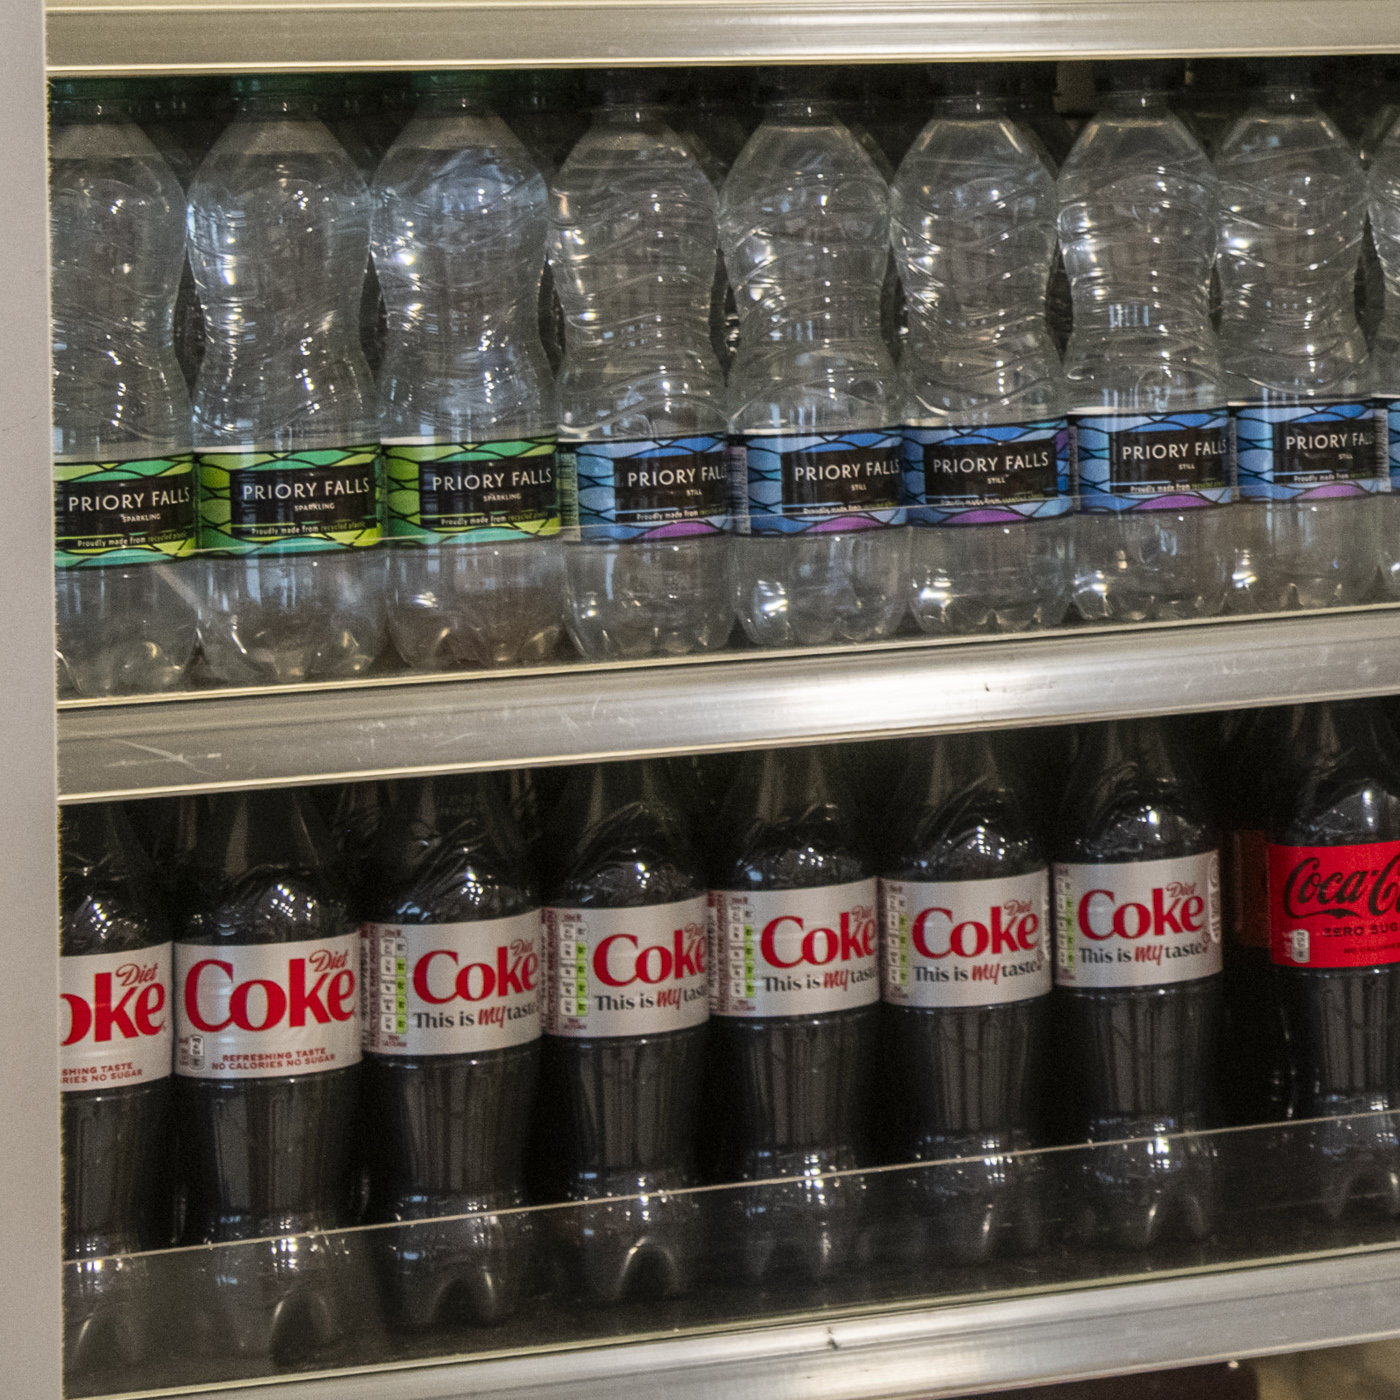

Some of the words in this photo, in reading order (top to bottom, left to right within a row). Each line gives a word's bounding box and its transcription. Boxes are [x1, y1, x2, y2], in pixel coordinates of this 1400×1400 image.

[1123, 443, 1188, 461] PRIORY
[1195, 439, 1227, 456] FALLS
[1286, 434, 1347, 451] PRIORY
[795, 463, 861, 482] PRIORY
[866, 459, 899, 477] FALLS
[933, 457, 998, 475] PRIORY
[1005, 452, 1048, 470] FALLS
[243, 482, 317, 501] PRIORY
[325, 477, 370, 496] FALLS
[432, 473, 505, 492] PRIORY
[512, 468, 552, 487] FALLS
[628, 468, 696, 488] PRIORY
[987, 476, 1005, 484] STILL
[69, 493, 145, 513] PRIORY
[152, 487, 190, 506] FALLS
[294, 502, 335, 513] SPARKLING
[483, 492, 522, 502] SPARKLING
[122, 513, 161, 524] SPARKLING
[78, 538, 106, 549] Proudly
[108, 536, 128, 546] made
[130, 535, 147, 545] from
[251, 526, 280, 537] Proudly
[281, 525, 299, 535] made
[301, 524, 319, 534] from
[1078, 887, 1204, 941] Coke
[760, 911, 877, 969] Coke
[912, 904, 1039, 959] Coke
[1322, 925, 1362, 939] ZERO
[308, 949, 349, 973] Diet
[1079, 947, 1113, 964] This
[1117, 946, 1132, 963] is
[1133, 944, 1164, 967] my
[115, 963, 159, 988] Diet
[412, 945, 538, 1004] Coke
[762, 975, 802, 994] This
[807, 974, 820, 991] is
[823, 969, 848, 992] my
[913, 965, 949, 983] This
[954, 963, 968, 981] is
[971, 961, 1000, 985] my
[184, 957, 356, 1033] Coke
[413, 1011, 455, 1029] This
[459, 1010, 475, 1027] is
[477, 1005, 506, 1029] my
[211, 1061, 228, 1071] NO
[229, 1058, 285, 1071] CALORIES
[286, 1056, 302, 1068] NO
[303, 1053, 336, 1066] SUGAR
[222, 1050, 291, 1063] REFRESHING
[293, 1047, 326, 1059] TASTE
[91, 1073, 109, 1083] NO
[110, 1069, 143, 1082] SUGAR
[101, 1062, 133, 1074] TASTE
